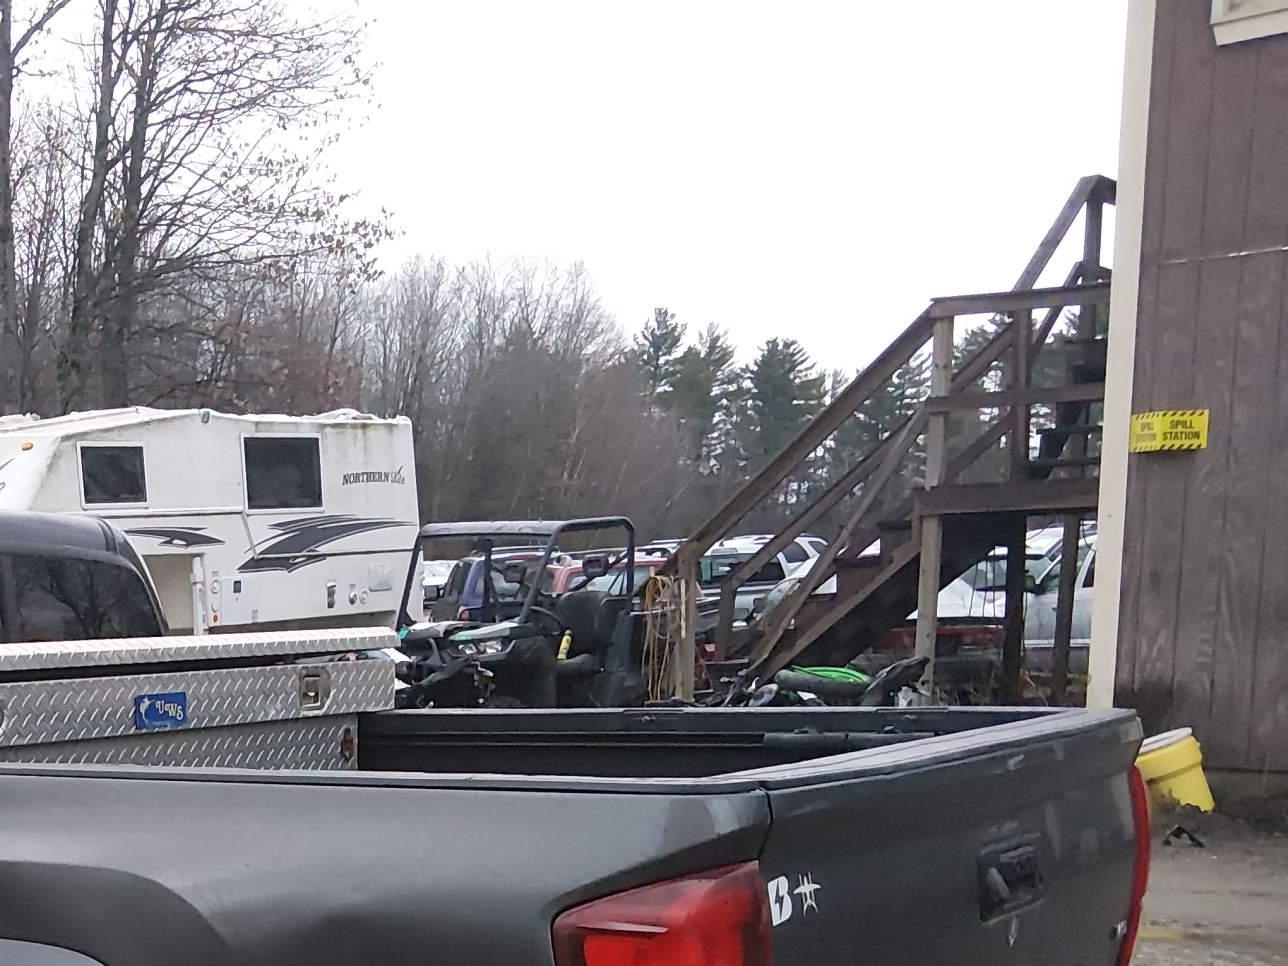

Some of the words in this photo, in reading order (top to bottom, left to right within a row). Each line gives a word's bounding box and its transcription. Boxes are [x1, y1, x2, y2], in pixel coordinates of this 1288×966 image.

[1169, 419, 1194, 429] SPILL
[1162, 431, 1201, 441] STATION
[341, 471, 389, 485] NORTHERN
